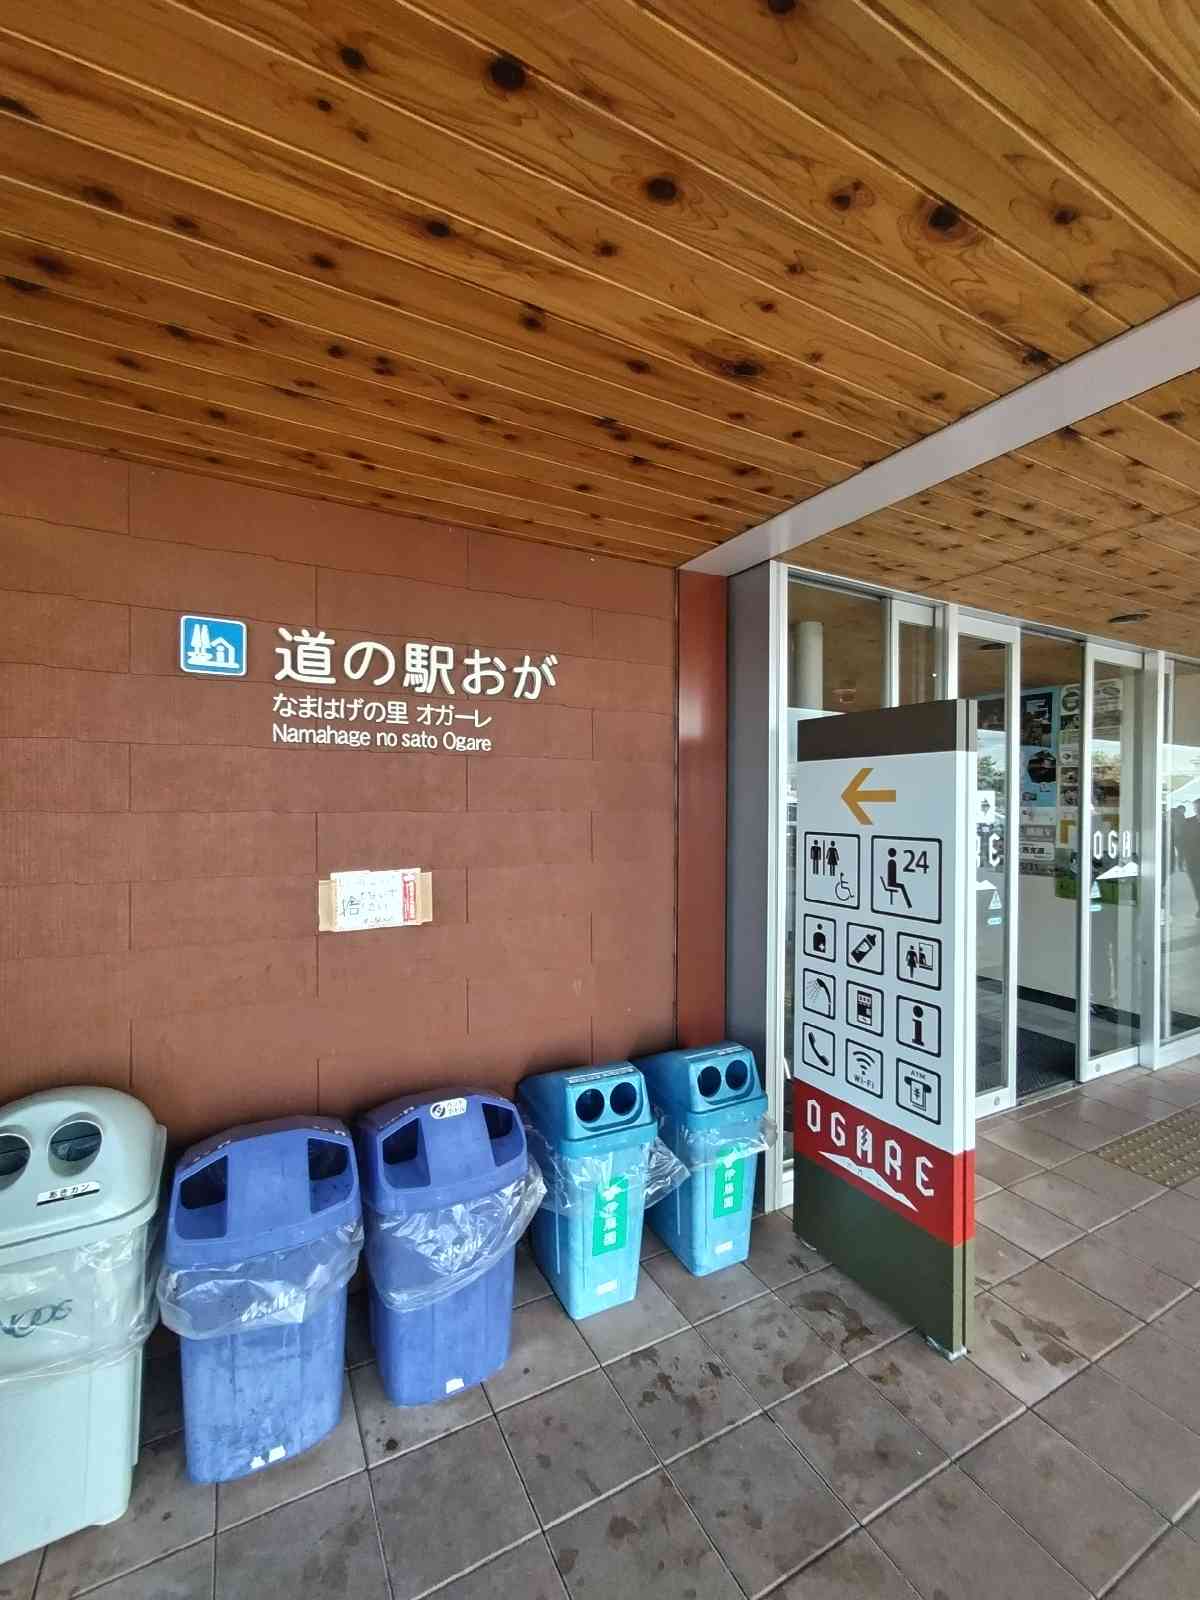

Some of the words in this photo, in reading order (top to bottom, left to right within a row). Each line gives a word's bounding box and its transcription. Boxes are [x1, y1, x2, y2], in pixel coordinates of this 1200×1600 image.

[274, 627, 559, 700] 道の駅おが
[272, 692, 409, 725] なまはげの里
[416, 702, 492, 728] オガーレ
[272, 723, 371, 747] Namahage
[376, 731, 398, 746] no
[401, 730, 438, 749] sato
[442, 731, 492, 751] Ogare
[902, 849, 929, 874] 24
[806, 1099, 935, 1197] OGARE
[48, 1184, 89, 1199] あきカン
